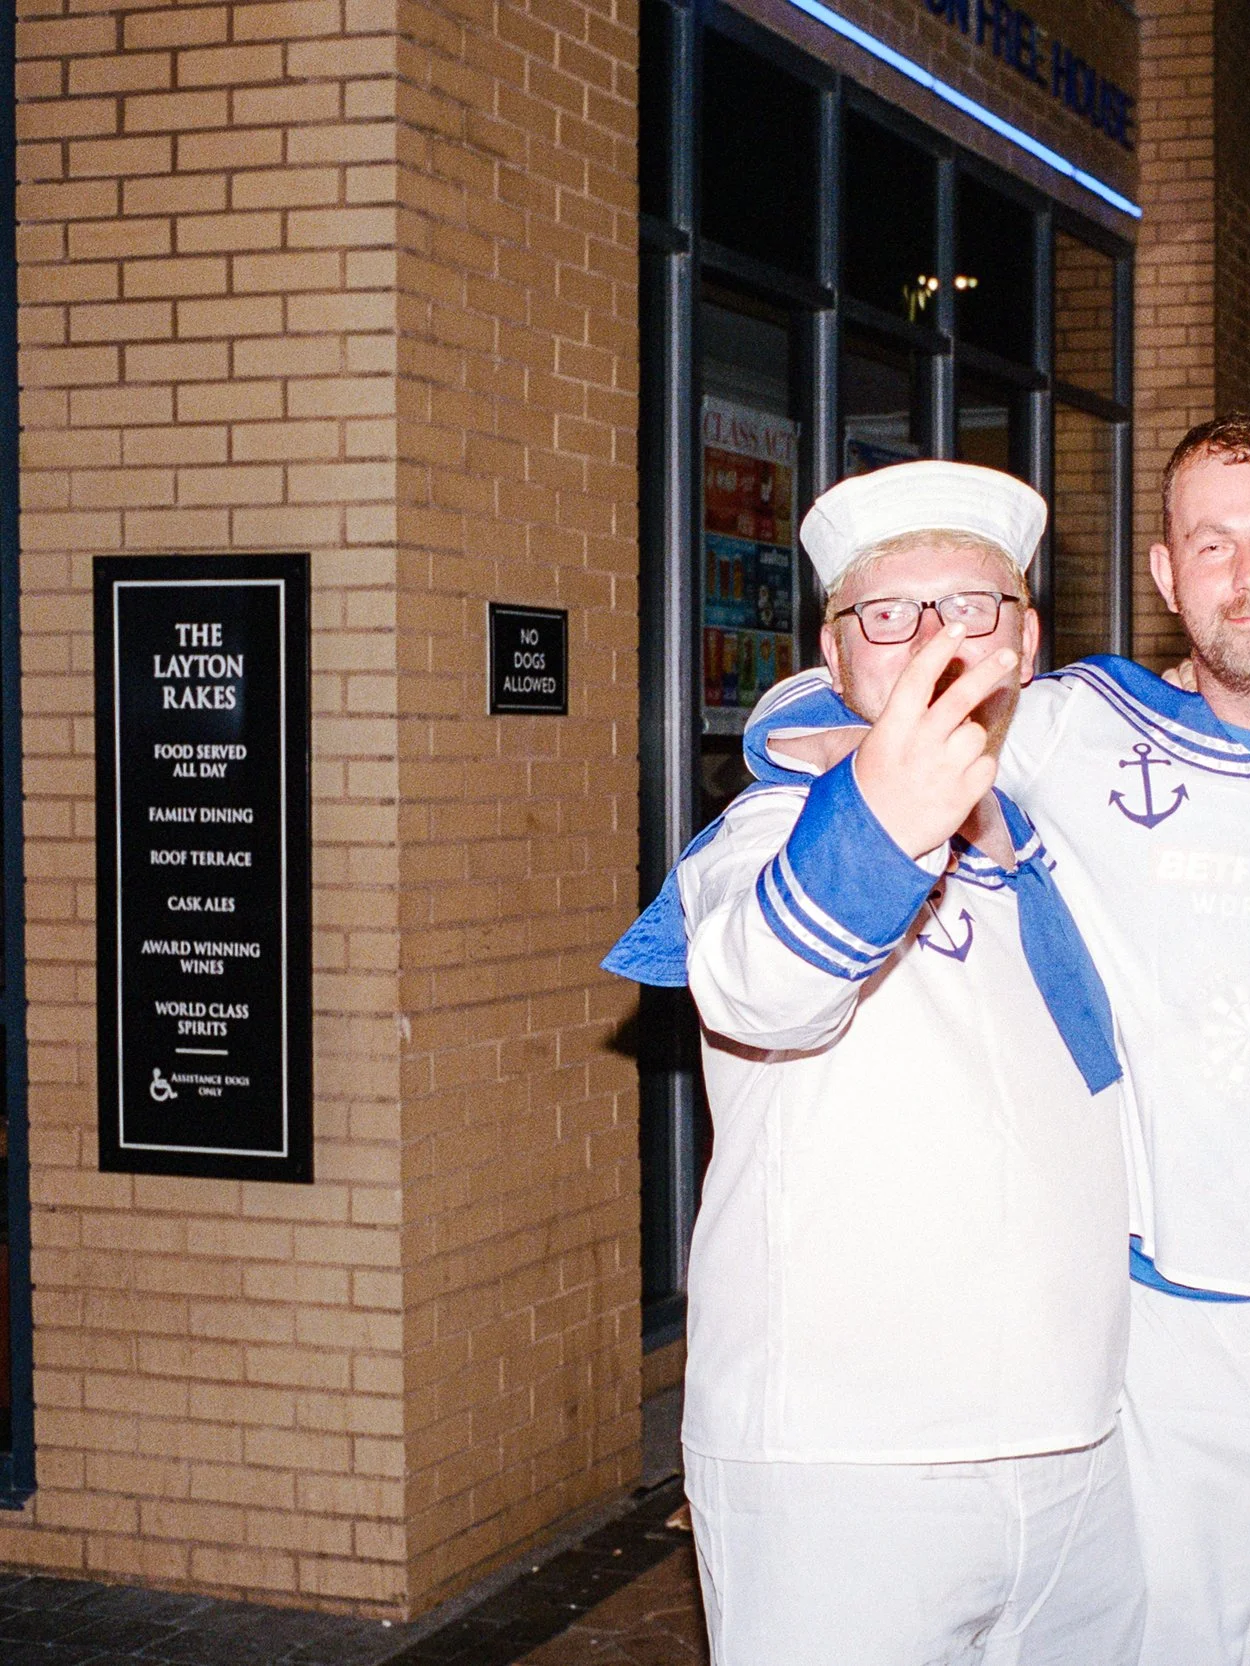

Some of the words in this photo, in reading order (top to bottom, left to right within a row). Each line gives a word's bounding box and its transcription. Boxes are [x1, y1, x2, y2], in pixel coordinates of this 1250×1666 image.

[175, 624, 222, 646] THE
[521, 629, 538, 645] NO
[154, 655, 243, 678] LAYTON
[514, 652, 545, 669] DOGS
[504, 676, 556, 693] ALLOWED
[163, 686, 236, 710] RAKES
[155, 744, 193, 759] FOOD
[197, 745, 246, 759] SERVED
[173, 763, 196, 777] ALL
[200, 763, 227, 777] DAY
[149, 807, 196, 822] FAMILY
[200, 808, 253, 823] DINING
[151, 850, 186, 865] ROOF
[190, 851, 251, 866] TERRACE
[168, 896, 202, 911] CASK
[204, 898, 235, 912] ALES
[142, 940, 191, 955] AWARD
[192, 942, 260, 957] WINNING
[180, 959, 223, 974] WINES
[155, 1001, 206, 1017] WORLD
[209, 1003, 249, 1019] CLASS
[178, 1021, 227, 1036] SPIRITS
[199, 1087, 222, 1096] ONLY
